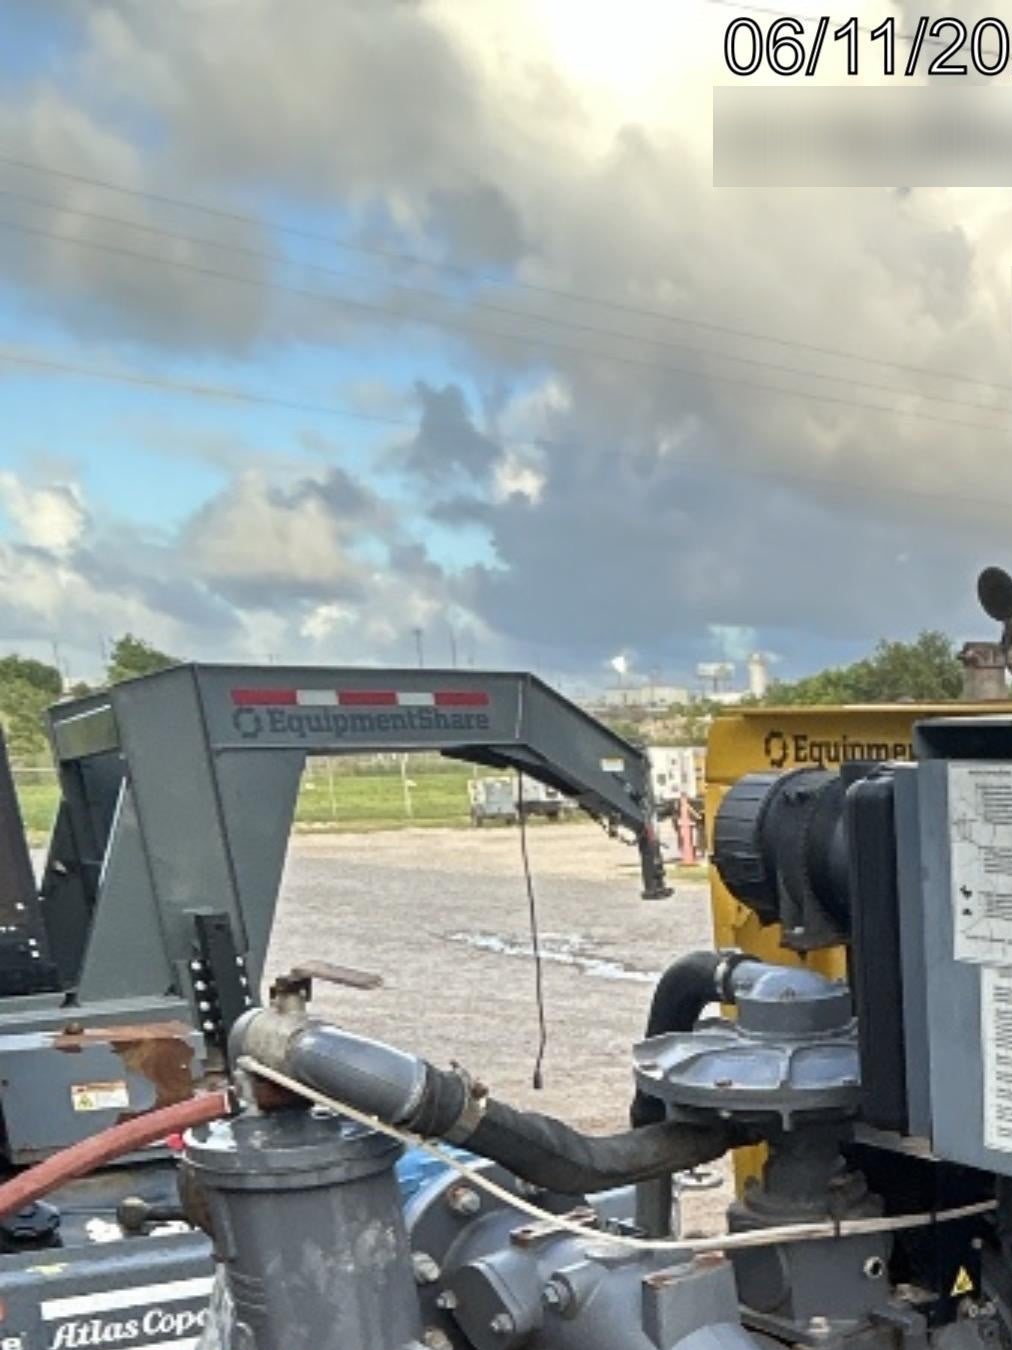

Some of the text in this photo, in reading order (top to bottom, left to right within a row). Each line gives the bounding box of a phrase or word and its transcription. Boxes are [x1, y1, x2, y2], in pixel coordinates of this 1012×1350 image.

[266, 706, 490, 739] EquipmentShare
[51, 1317, 138, 1350] Atlas
[142, 1307, 212, 1336] Copc
